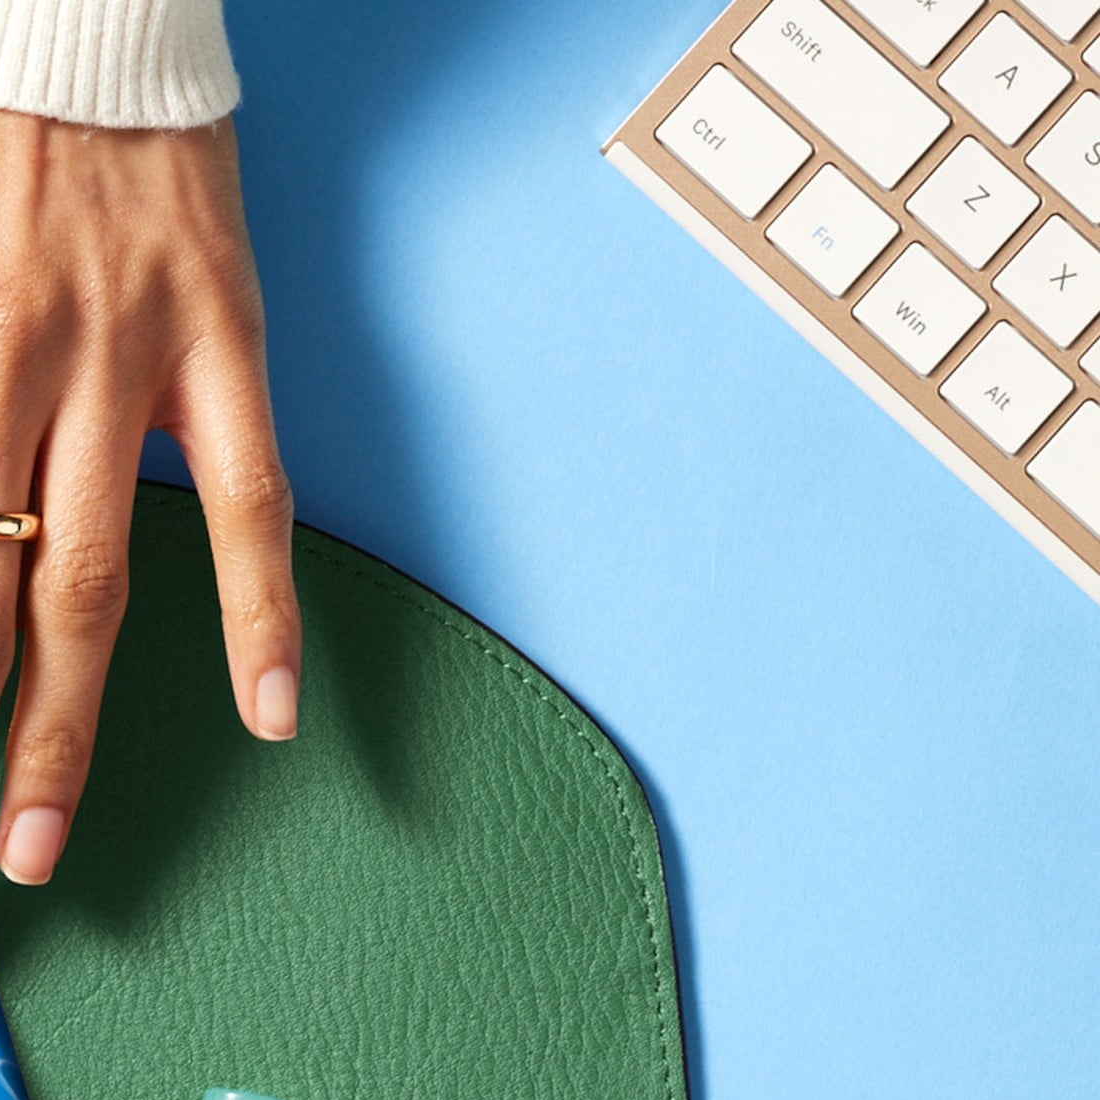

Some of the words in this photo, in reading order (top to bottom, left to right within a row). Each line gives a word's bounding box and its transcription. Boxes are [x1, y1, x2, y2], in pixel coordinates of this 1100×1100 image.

[780, 21, 822, 63] Shift
[995, 65, 1018, 90] A
[692, 118, 727, 151] Ctrl
[963, 185, 990, 212] Z
[812, 226, 834, 251] Fn
[1049, 263, 1077, 292] X
[895, 301, 927, 335] Win
[984, 385, 1011, 411] Alt
